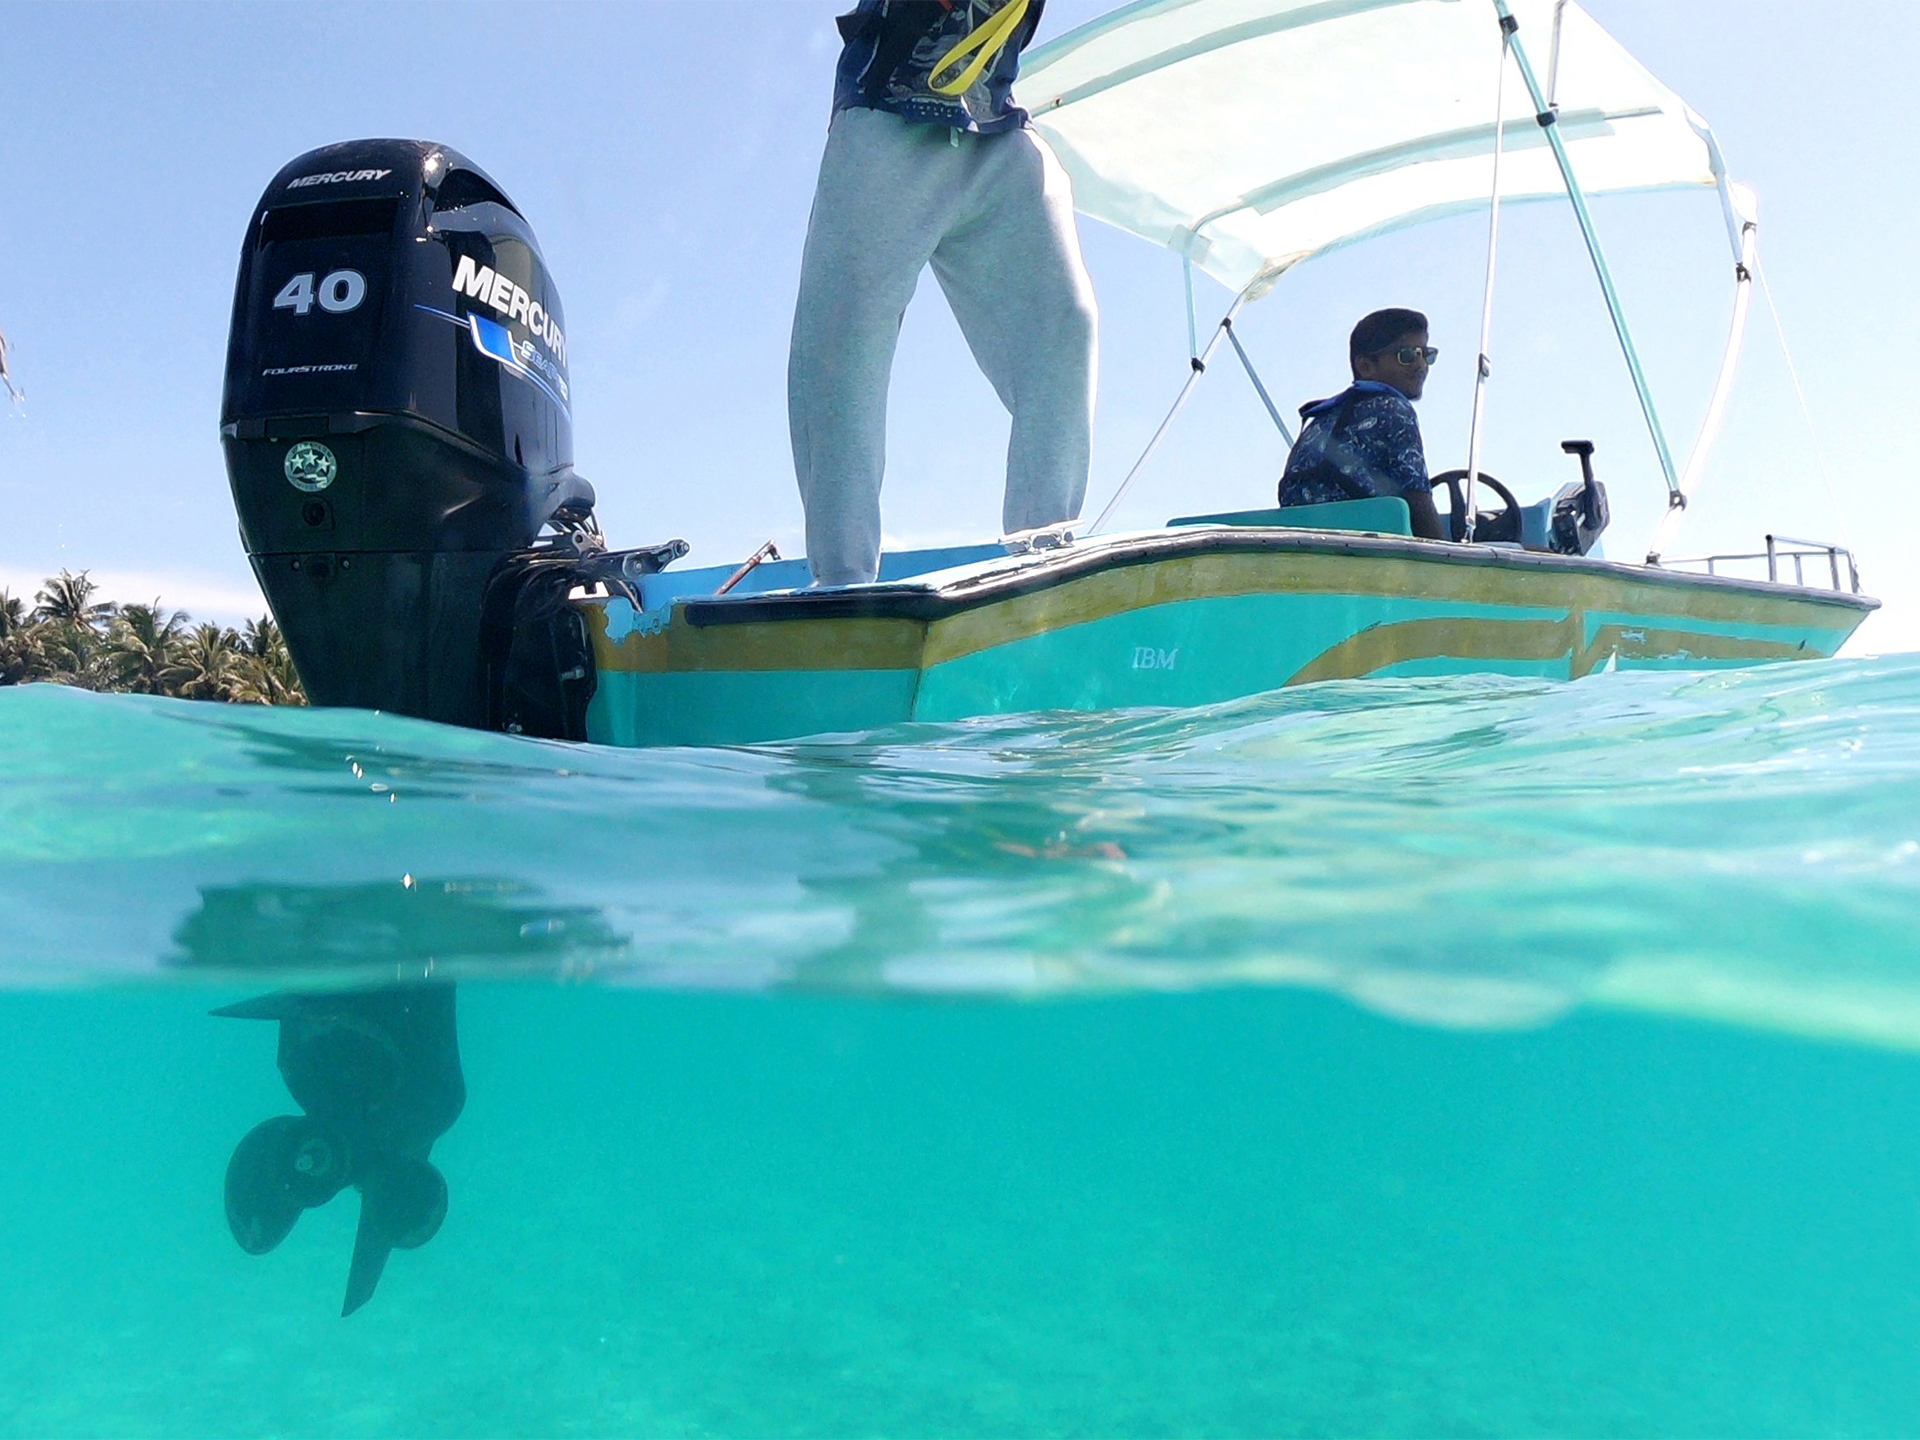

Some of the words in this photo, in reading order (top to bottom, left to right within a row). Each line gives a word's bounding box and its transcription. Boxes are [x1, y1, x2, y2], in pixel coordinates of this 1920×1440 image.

[286, 169, 392, 189] MERCURY
[273, 268, 368, 316] 40
[452, 254, 566, 368] MERCURY
[262, 363, 358, 376] FOURSTROKE
[1131, 646, 1178, 670] IBM
